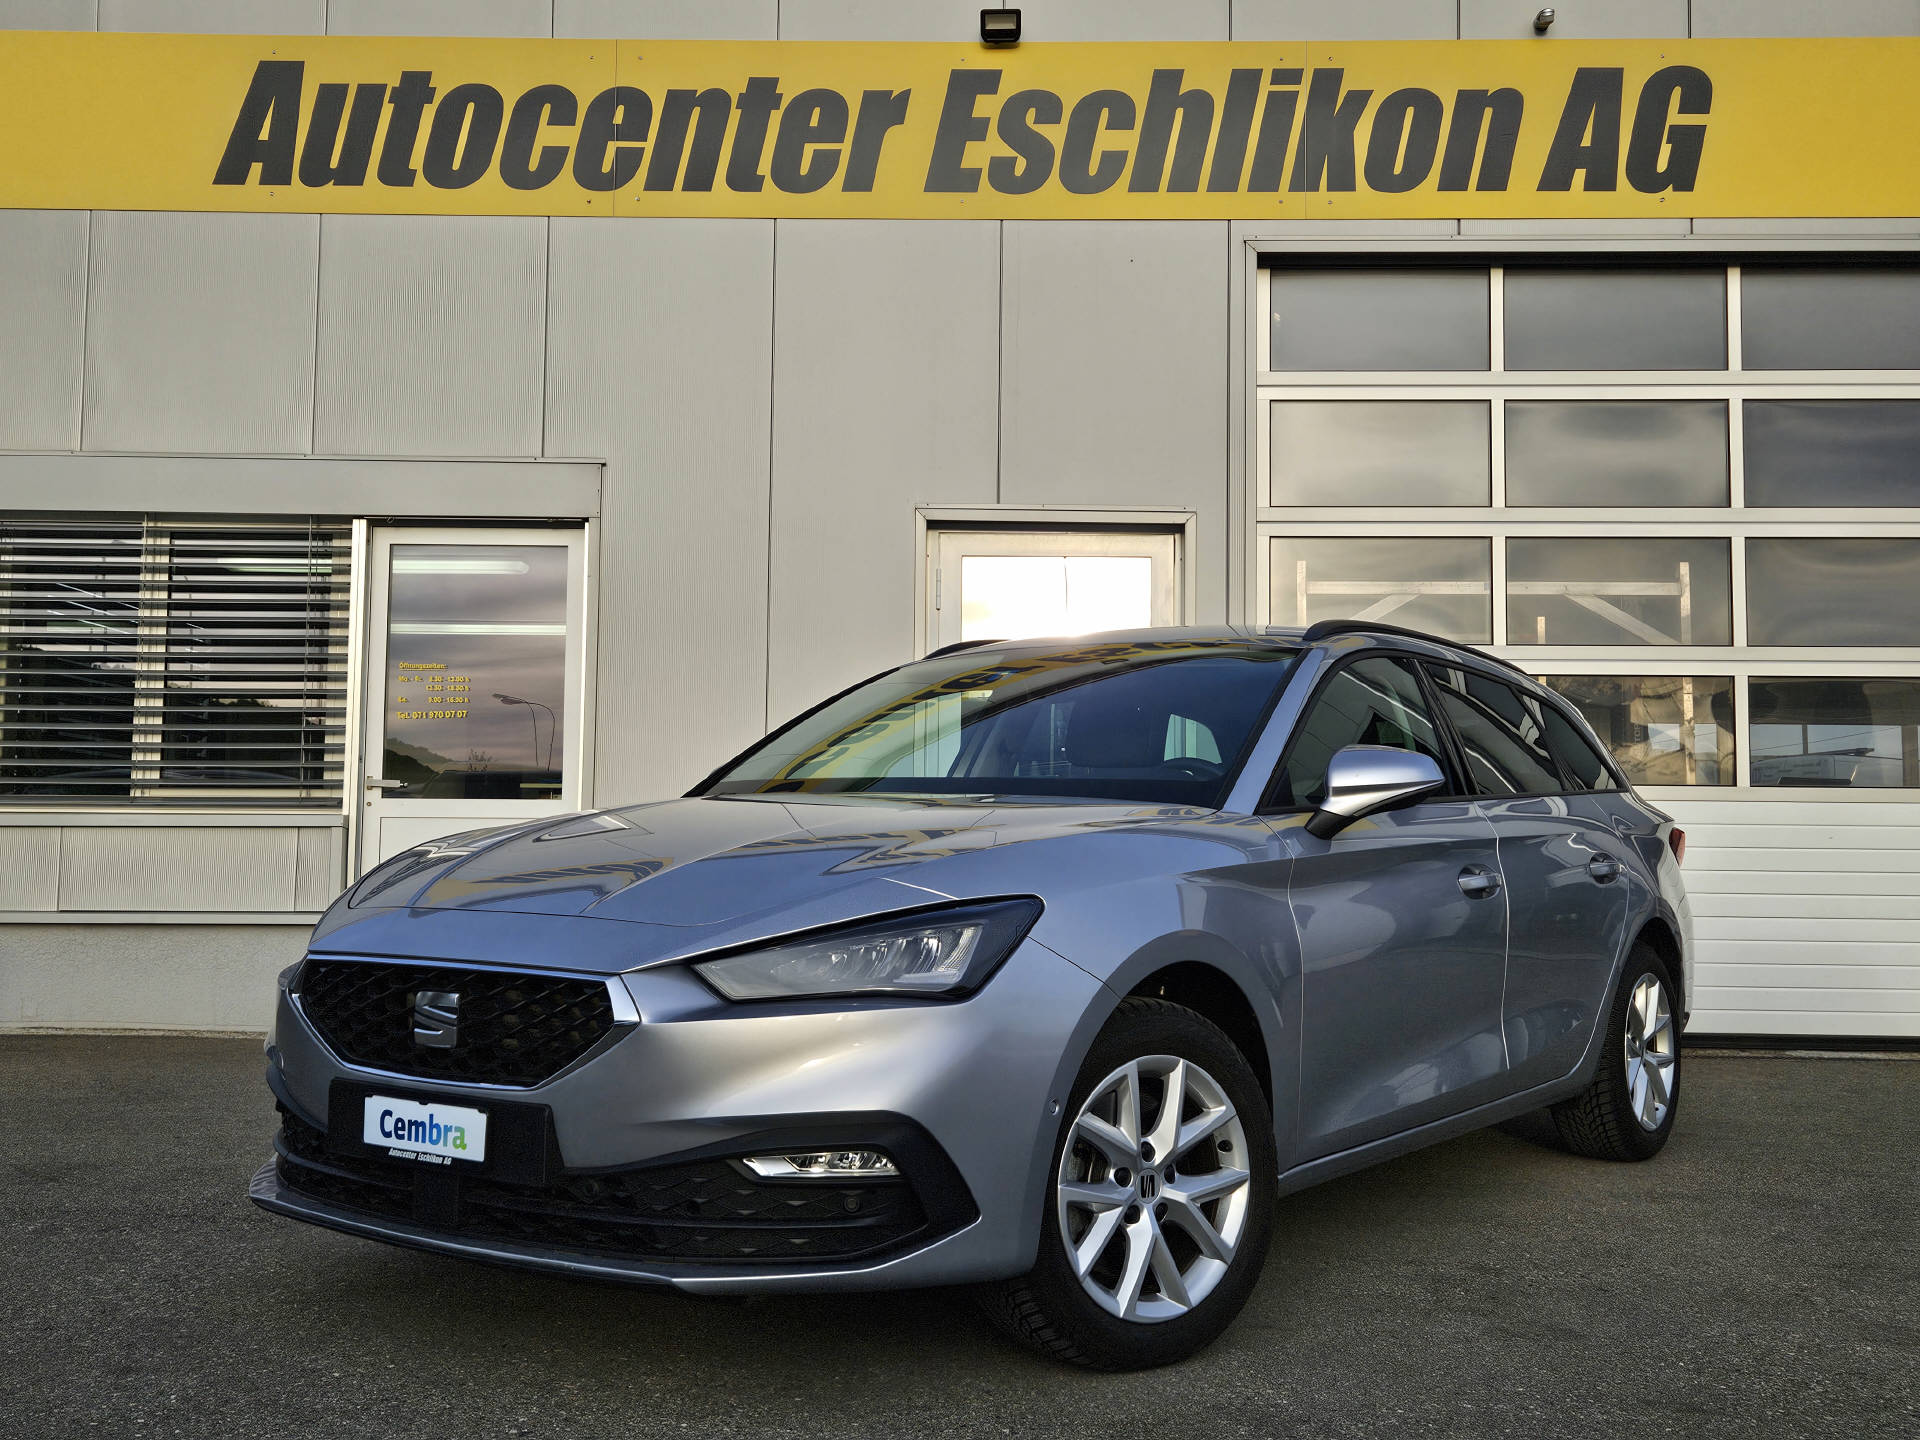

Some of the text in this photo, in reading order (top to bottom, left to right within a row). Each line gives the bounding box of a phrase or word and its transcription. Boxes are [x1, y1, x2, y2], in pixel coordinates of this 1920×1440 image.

[212, 60, 1713, 195] Autocenter Eschlikon AG
[412, 711, 426, 719] 071
[429, 711, 443, 719] 970
[445, 710, 456, 718] 07
[457, 710, 467, 718] 07
[380, 1109, 467, 1150] Cembra
[389, 1147, 452, 1165] Autocenter Eschlikon AG
